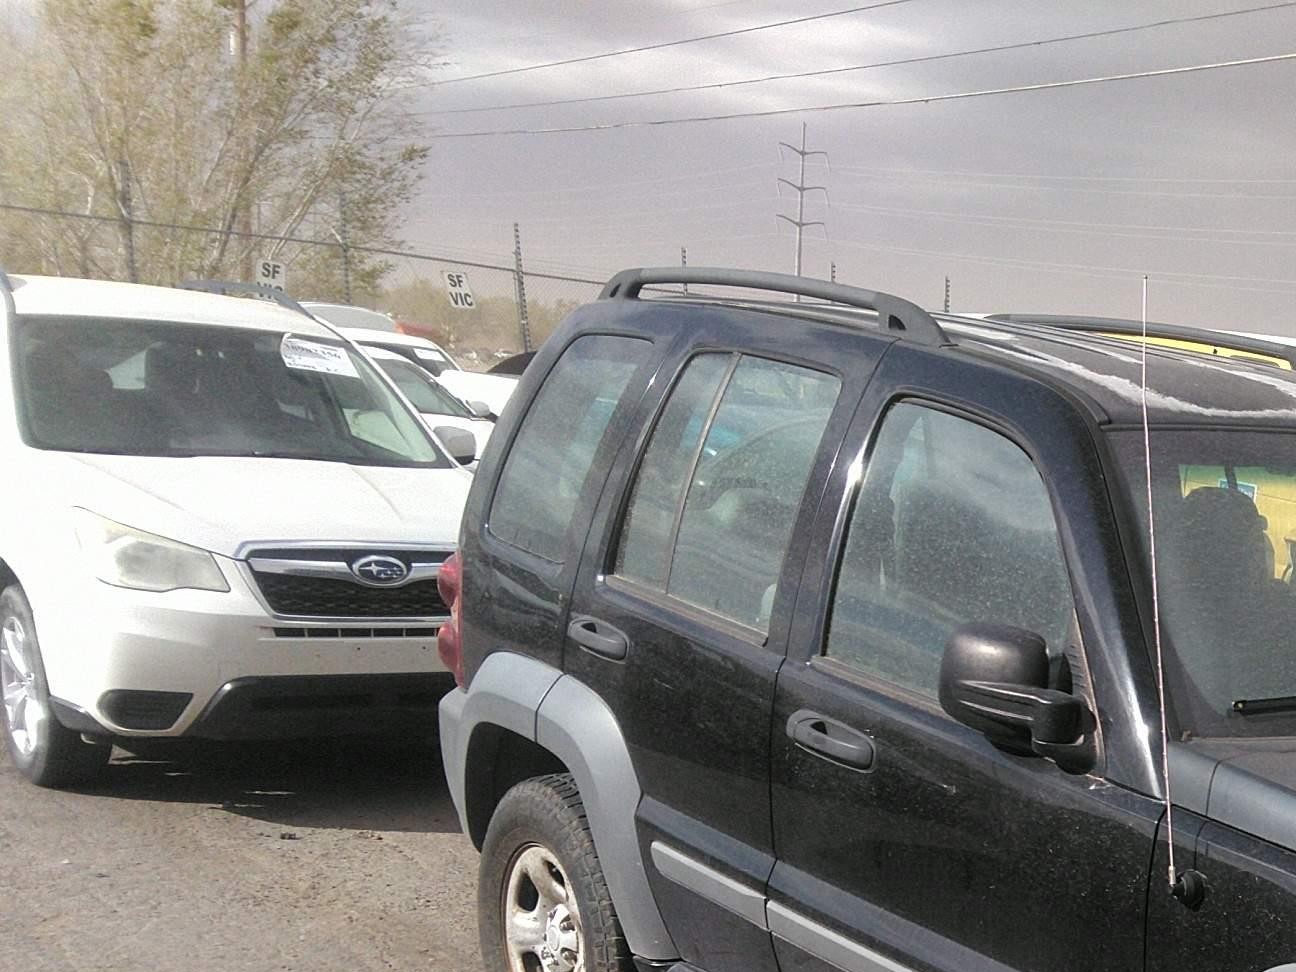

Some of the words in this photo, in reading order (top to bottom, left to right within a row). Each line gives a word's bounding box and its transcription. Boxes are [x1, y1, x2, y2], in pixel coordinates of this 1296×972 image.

[261, 262, 281, 280] SF
[447, 273, 465, 289] SF
[449, 292, 474, 308] VIC
